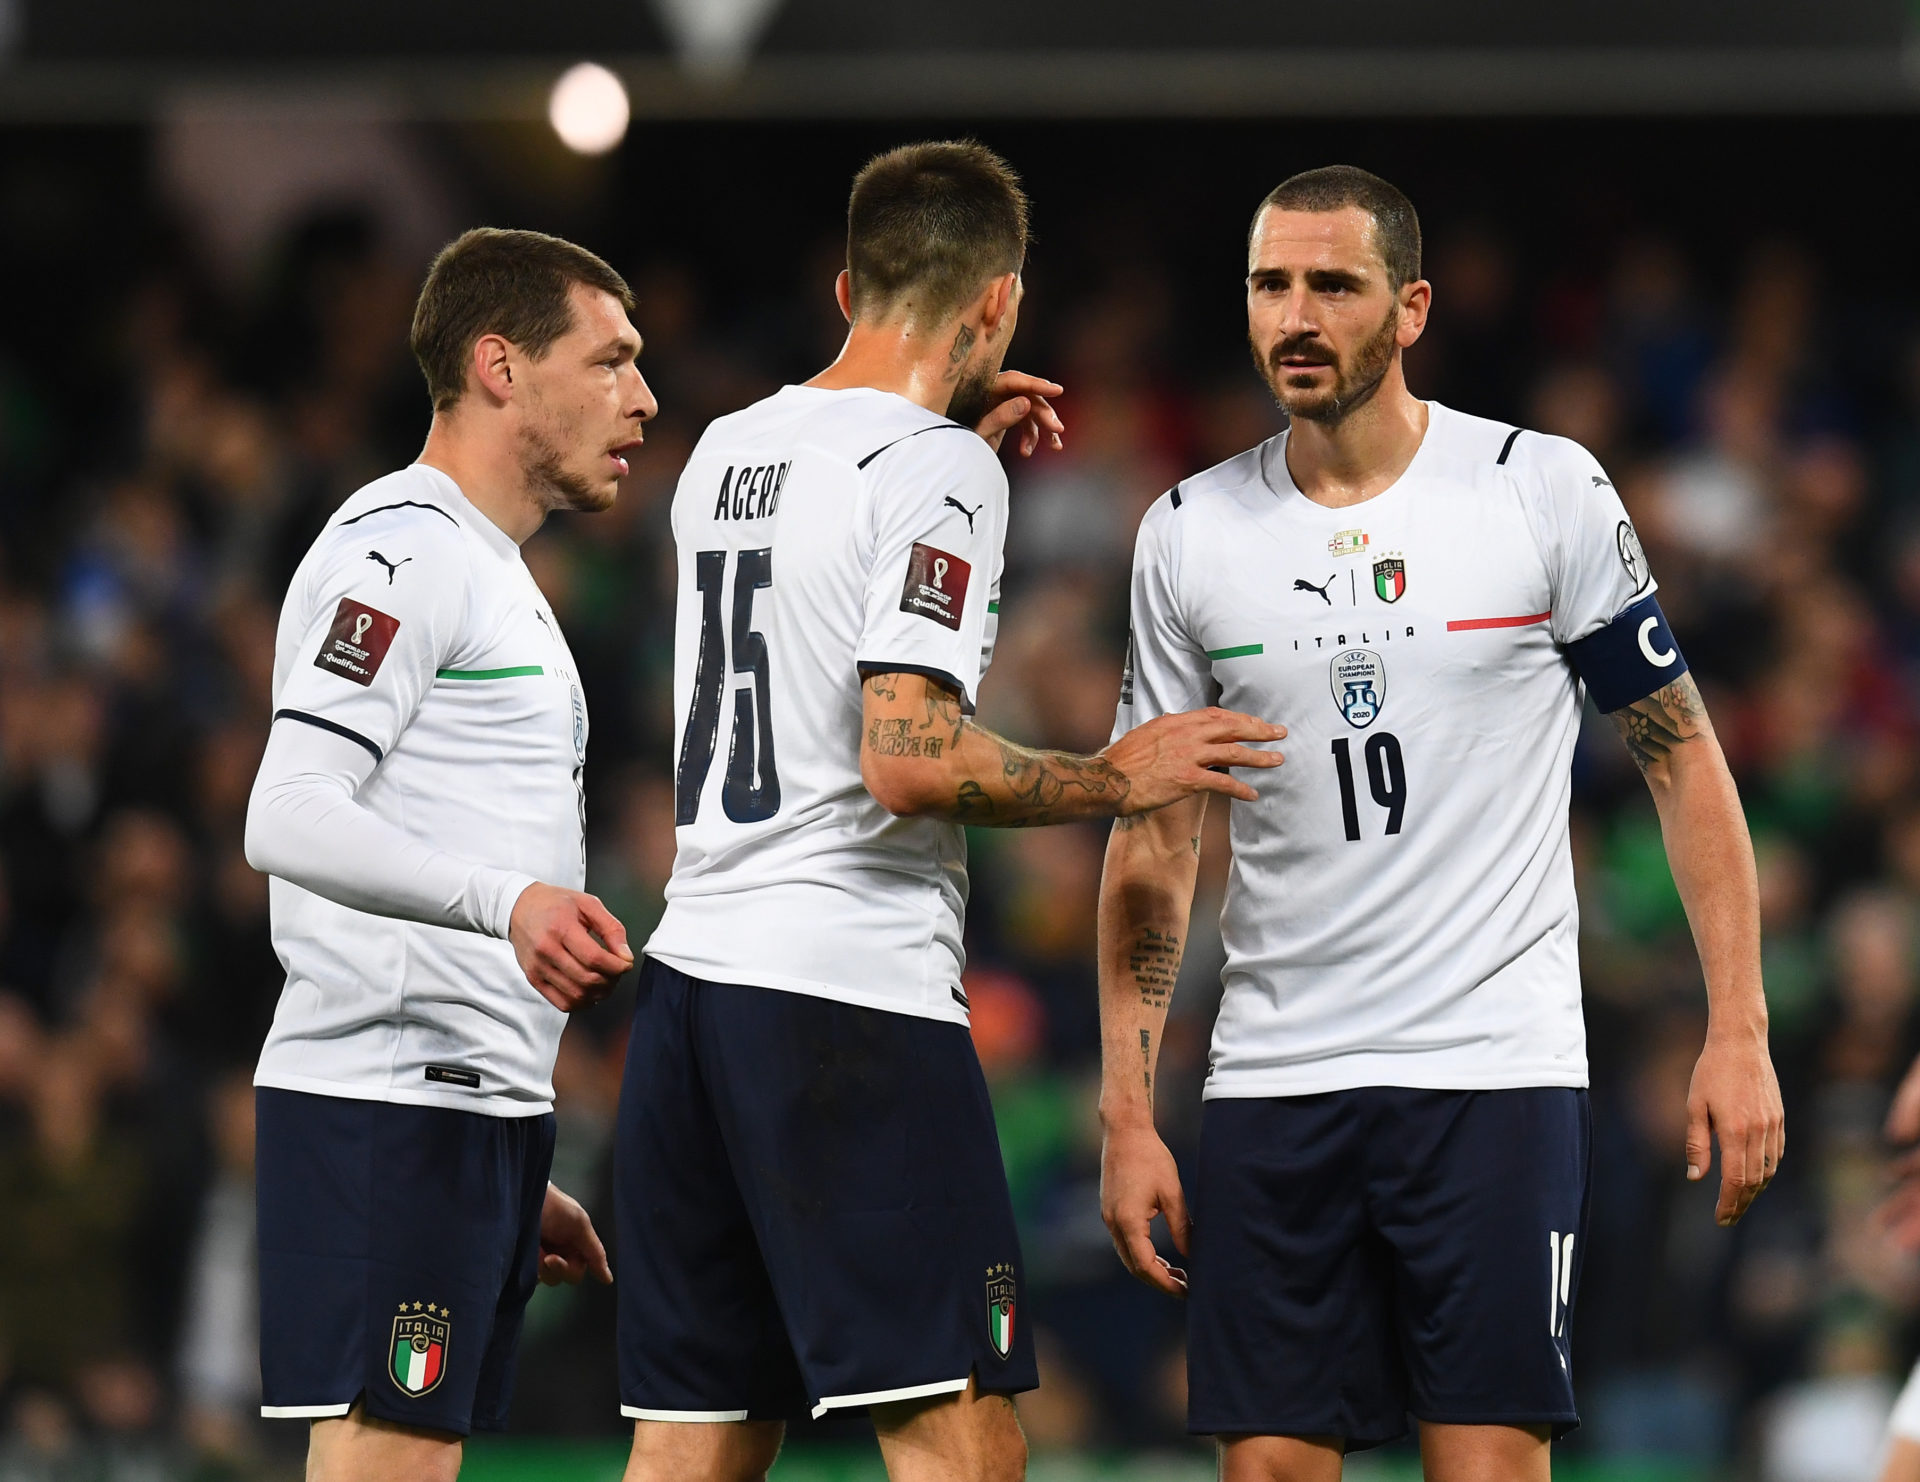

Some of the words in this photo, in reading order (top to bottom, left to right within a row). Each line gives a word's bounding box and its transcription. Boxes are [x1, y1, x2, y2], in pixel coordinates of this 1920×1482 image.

[1375, 561, 1403, 572] ITALIA
[1294, 626, 1415, 650] ITALIA
[1637, 616, 1677, 668] C
[326, 652, 365, 675] Qualifiers
[1344, 652, 1366, 663] UEFA
[1338, 664, 1375, 672] EUROPEAN
[1339, 670, 1376, 678] CHAMPIONS
[675, 547, 781, 825] 15
[1352, 711, 1371, 719] 2020
[1331, 731, 1407, 842] 19
[399, 1321, 444, 1338] ITALIA
